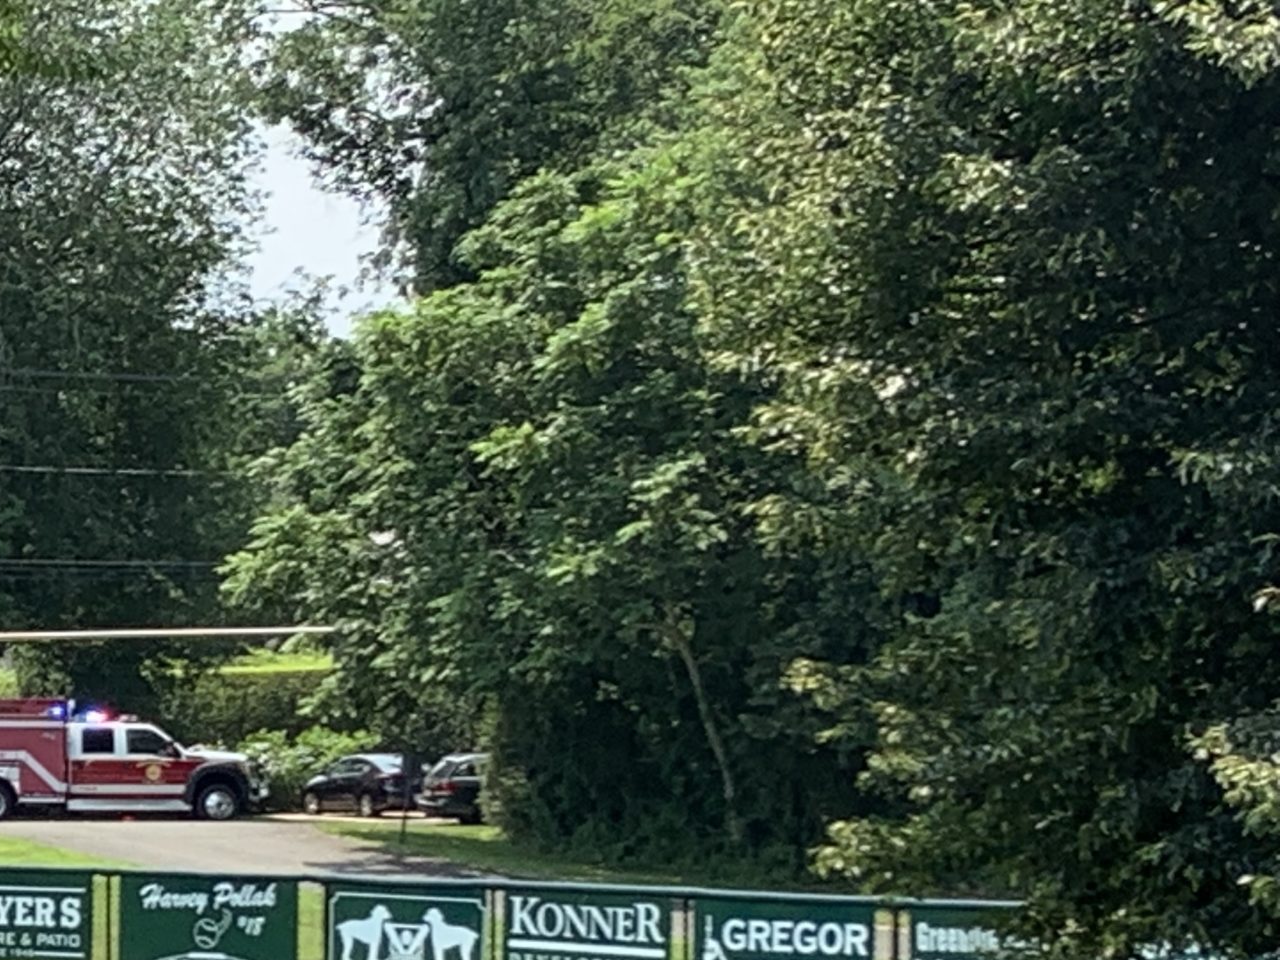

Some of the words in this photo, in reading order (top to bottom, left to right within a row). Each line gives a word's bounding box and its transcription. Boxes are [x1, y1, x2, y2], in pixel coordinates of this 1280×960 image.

[509, 895, 666, 944] KONNER
[721, 918, 869, 956] GREGOR
[20, 932, 32, 946] &
[36, 933, 81, 948] PATIO
